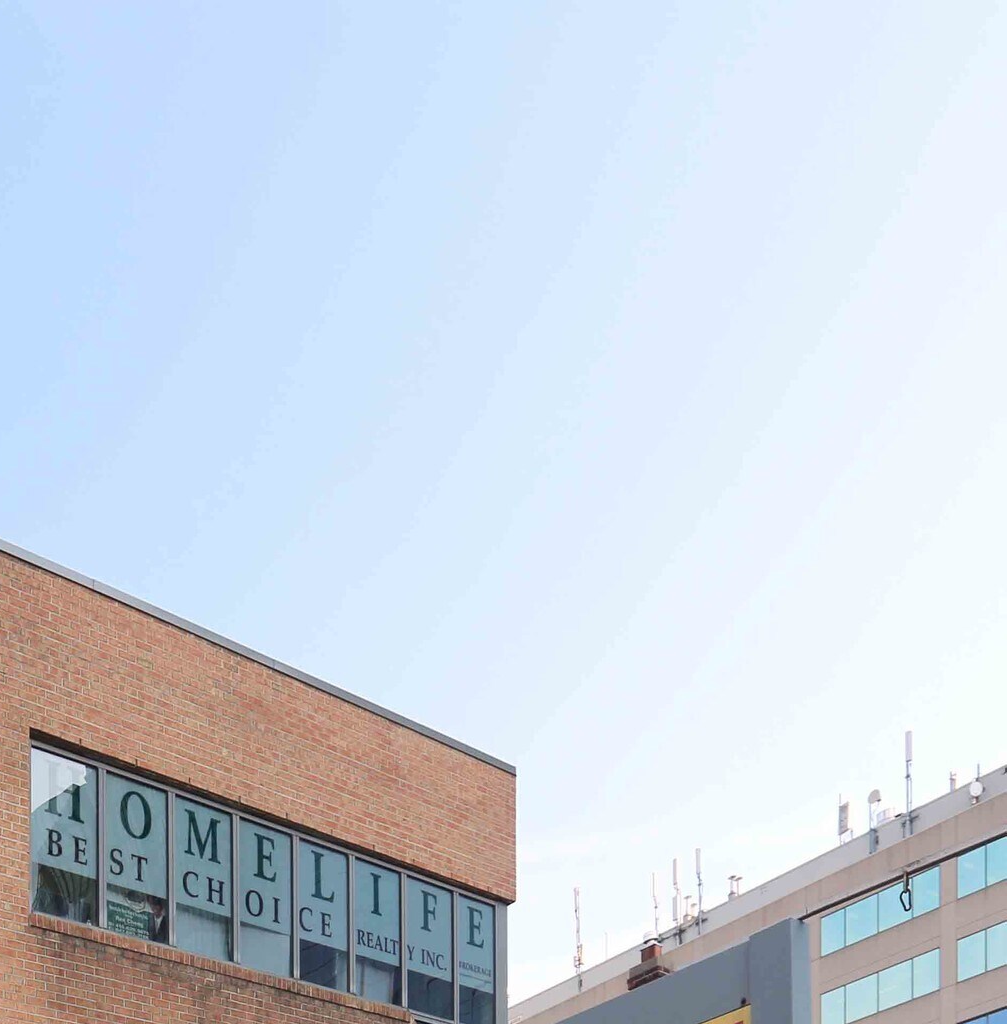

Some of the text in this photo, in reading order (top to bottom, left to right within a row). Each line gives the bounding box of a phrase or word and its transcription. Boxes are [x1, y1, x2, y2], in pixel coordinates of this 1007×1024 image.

[45, 762, 484, 949] HOMELIFE
[46, 828, 148, 882] BEST
[183, 871, 332, 938] CHOICE
[356, 929, 415, 961] REALTY
[421, 949, 447, 971] INC.
